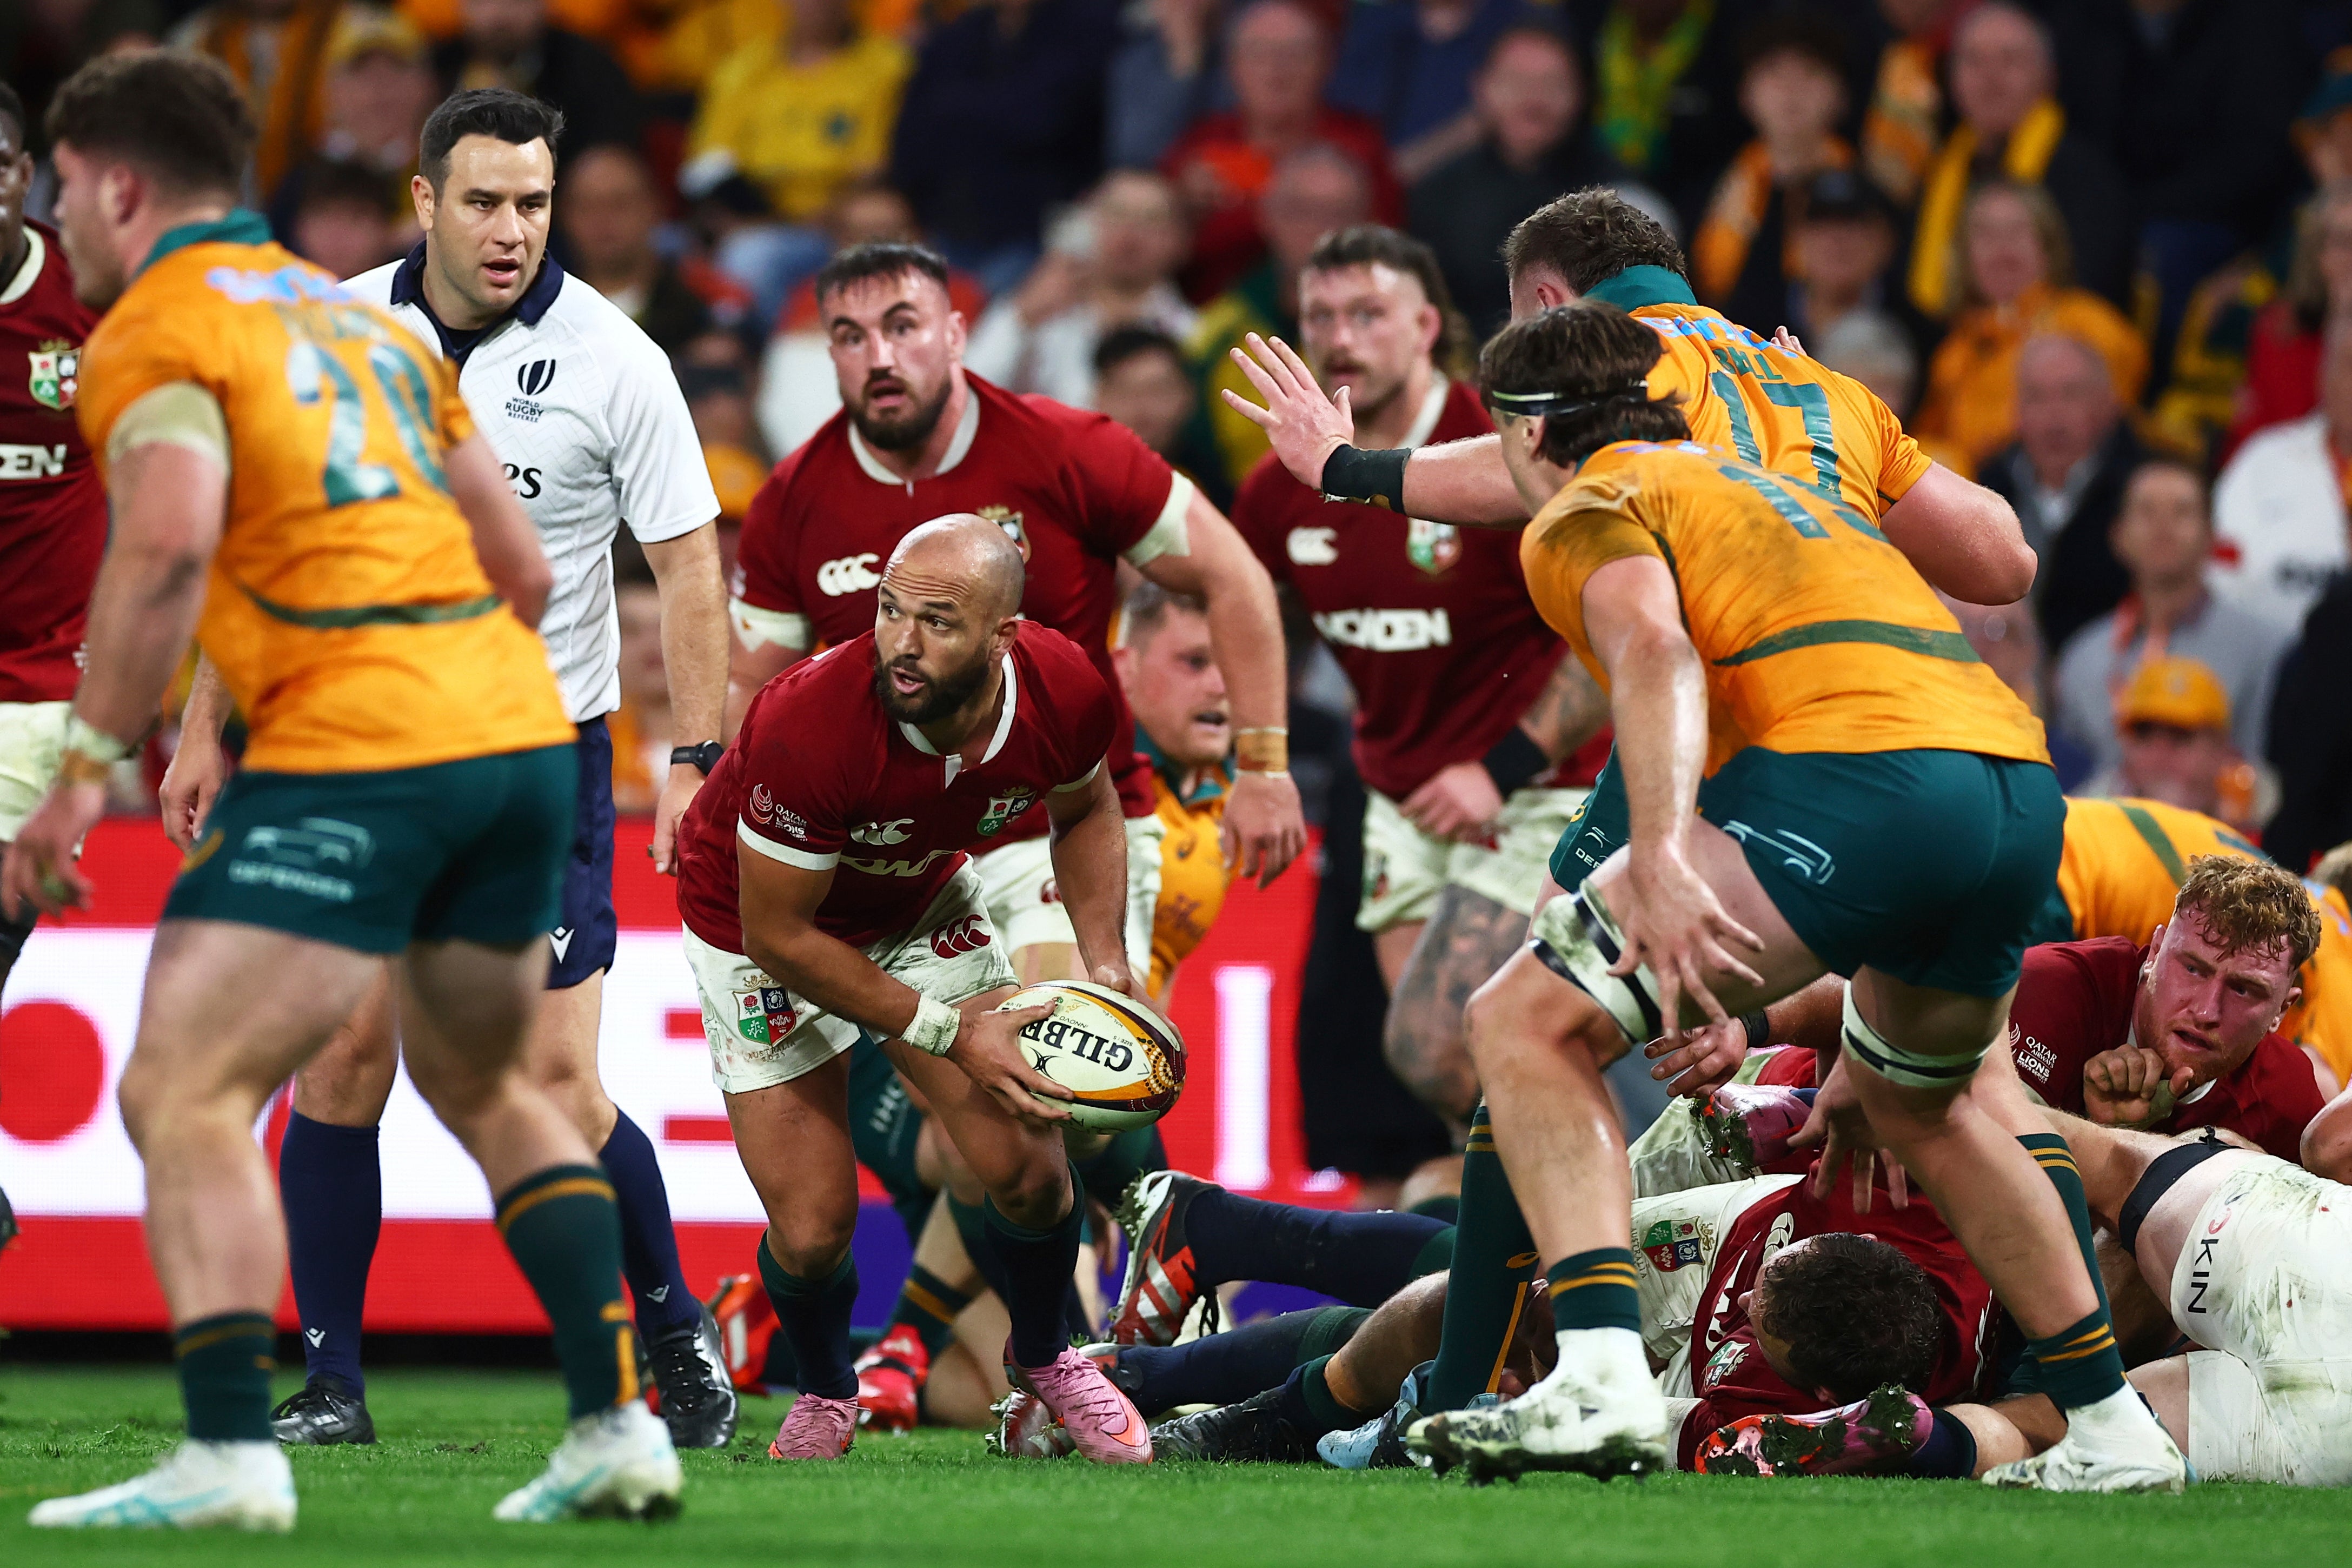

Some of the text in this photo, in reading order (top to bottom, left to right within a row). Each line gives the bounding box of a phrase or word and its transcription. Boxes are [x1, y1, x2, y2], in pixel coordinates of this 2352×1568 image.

[505, 402, 544, 417] RUGBY
[512, 396, 540, 408] WORLD
[285, 341, 455, 508] 20
[1709, 369, 1842, 502] 17
[775, 803, 807, 824] QATAR
[748, 1041, 796, 1060] AUSTRALIA
[1016, 1018, 1133, 1072] GILBE
[1120, 1038, 1133, 1047] SIZE
[2025, 1036, 2057, 1064] QATAR
[2018, 1051, 2050, 1078] LIONS
[2030, 1049, 2055, 1069] AIRWAYS
[1630, 1227, 1647, 1279] AUSTRALIA
[2188, 1239, 2219, 1314] KIN
